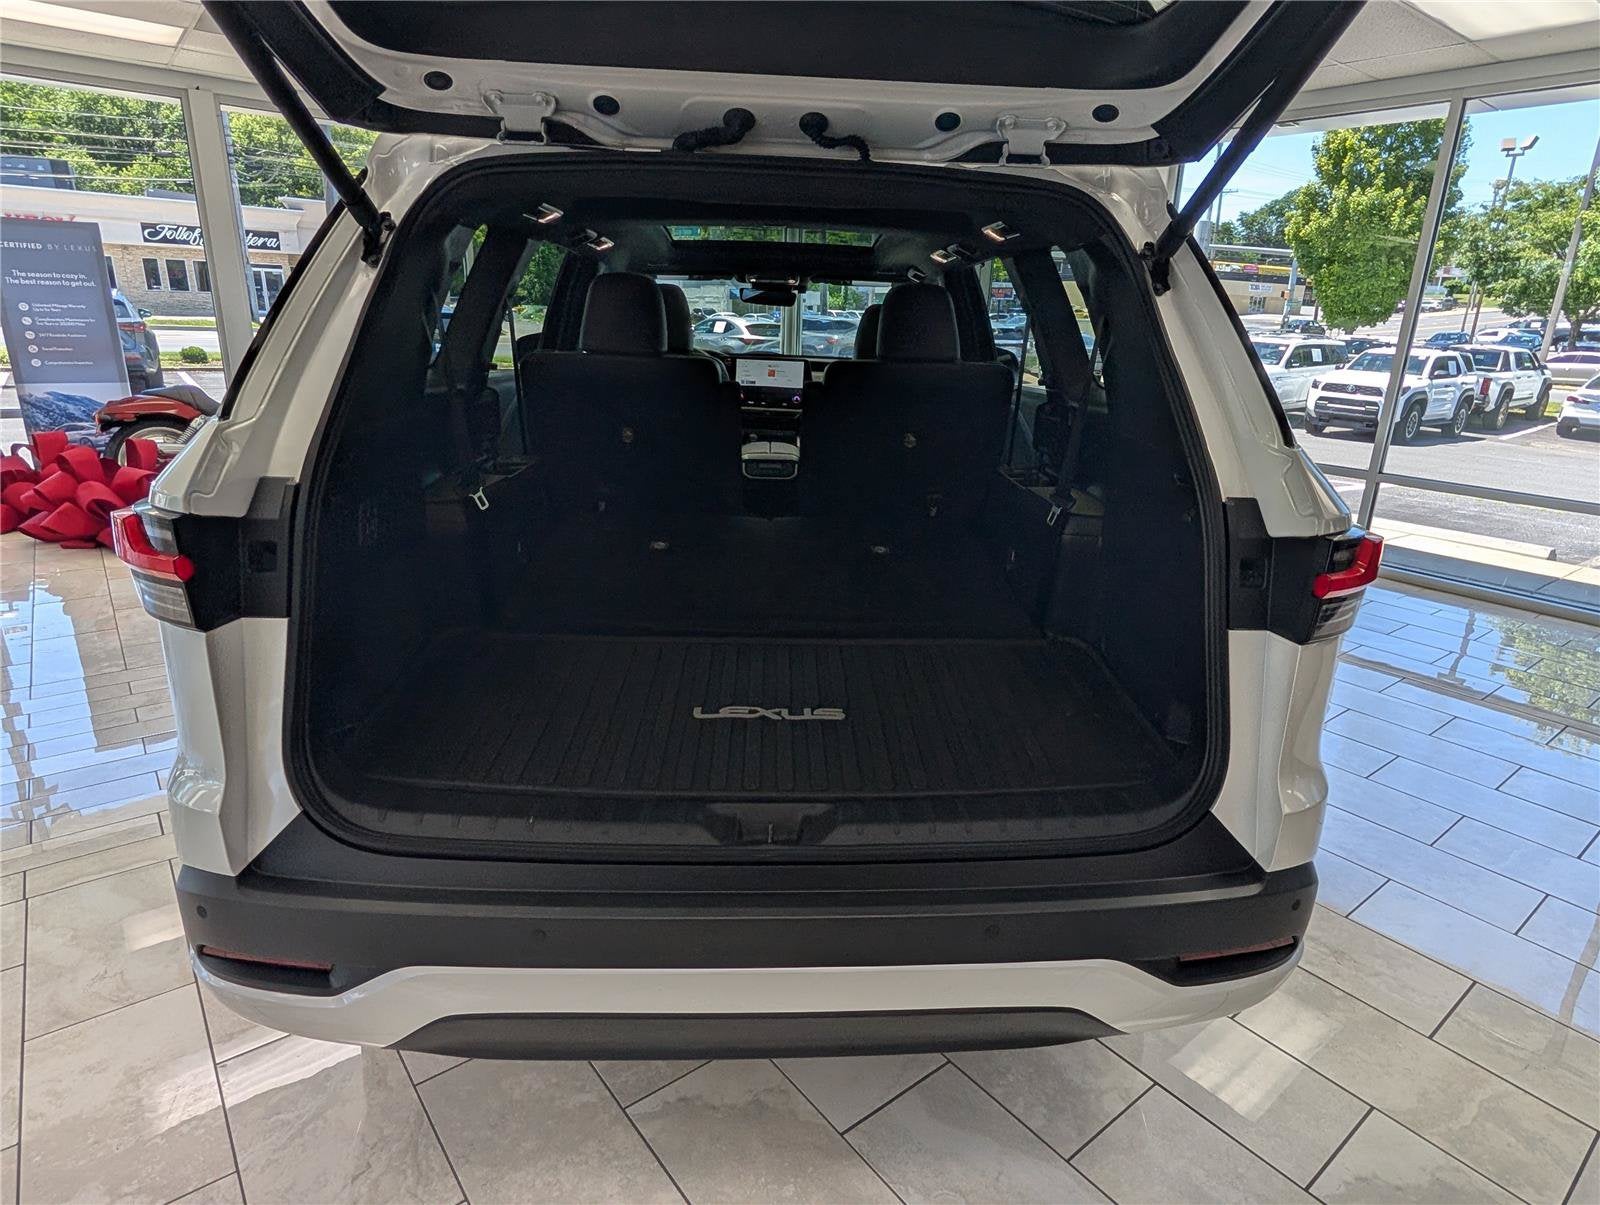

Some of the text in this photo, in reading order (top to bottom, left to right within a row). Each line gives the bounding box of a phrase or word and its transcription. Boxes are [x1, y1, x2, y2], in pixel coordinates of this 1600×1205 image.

[11, 269, 26, 277] The
[71, 280, 83, 288] get
[692, 705, 846, 720] LEXUS
